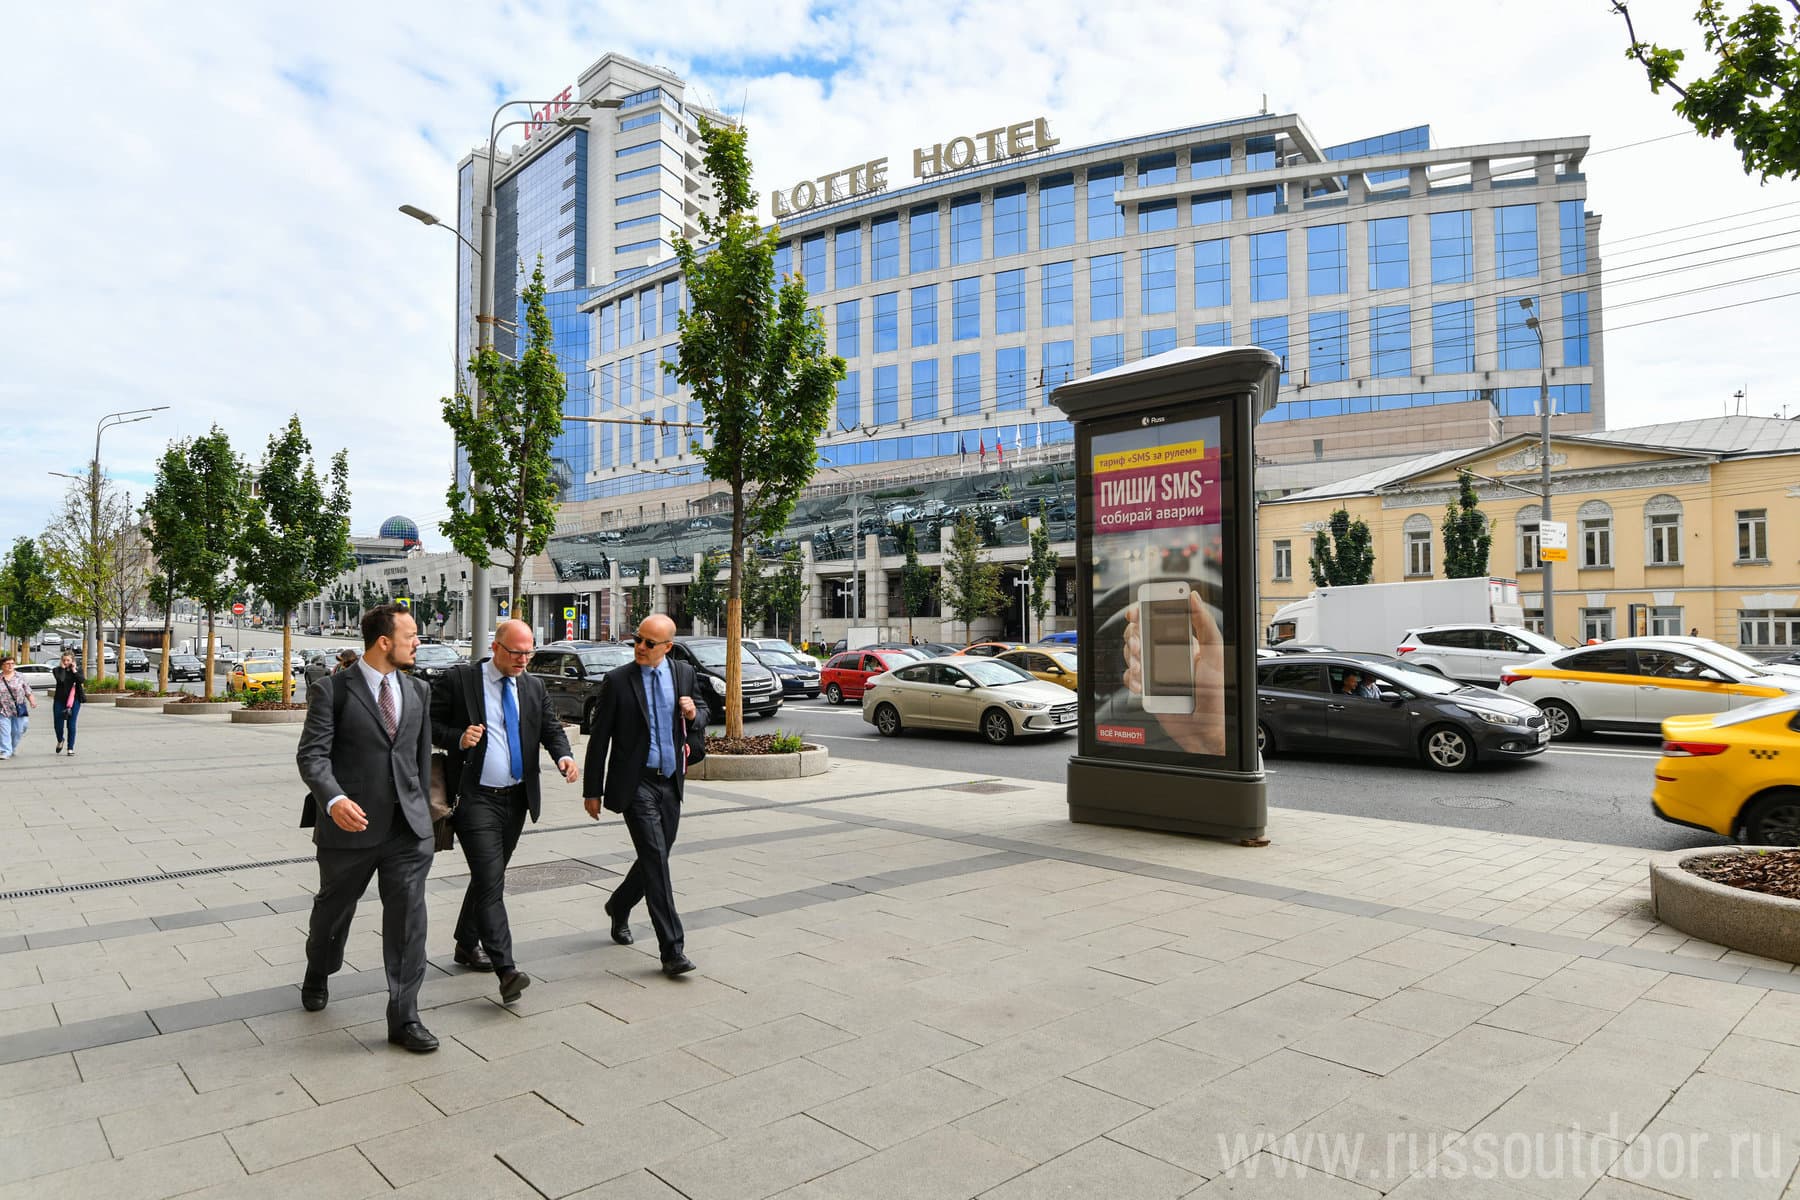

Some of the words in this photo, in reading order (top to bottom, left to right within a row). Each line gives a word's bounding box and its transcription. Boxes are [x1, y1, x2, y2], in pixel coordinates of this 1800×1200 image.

[524, 85, 572, 141] LOTTE
[771, 157, 888, 218] LOTTE
[913, 117, 1060, 178] HOTEL
[1099, 456, 1126, 468] тариф
[1127, 451, 1151, 463] «SMS
[1153, 452, 1162, 460] за
[1164, 447, 1197, 460] рулем»
[1101, 476, 1156, 507] ПИШИ
[1101, 507, 1152, 526] собирай
[1156, 505, 1204, 521] аварии
[1100, 728, 1113, 737] ВСЁ
